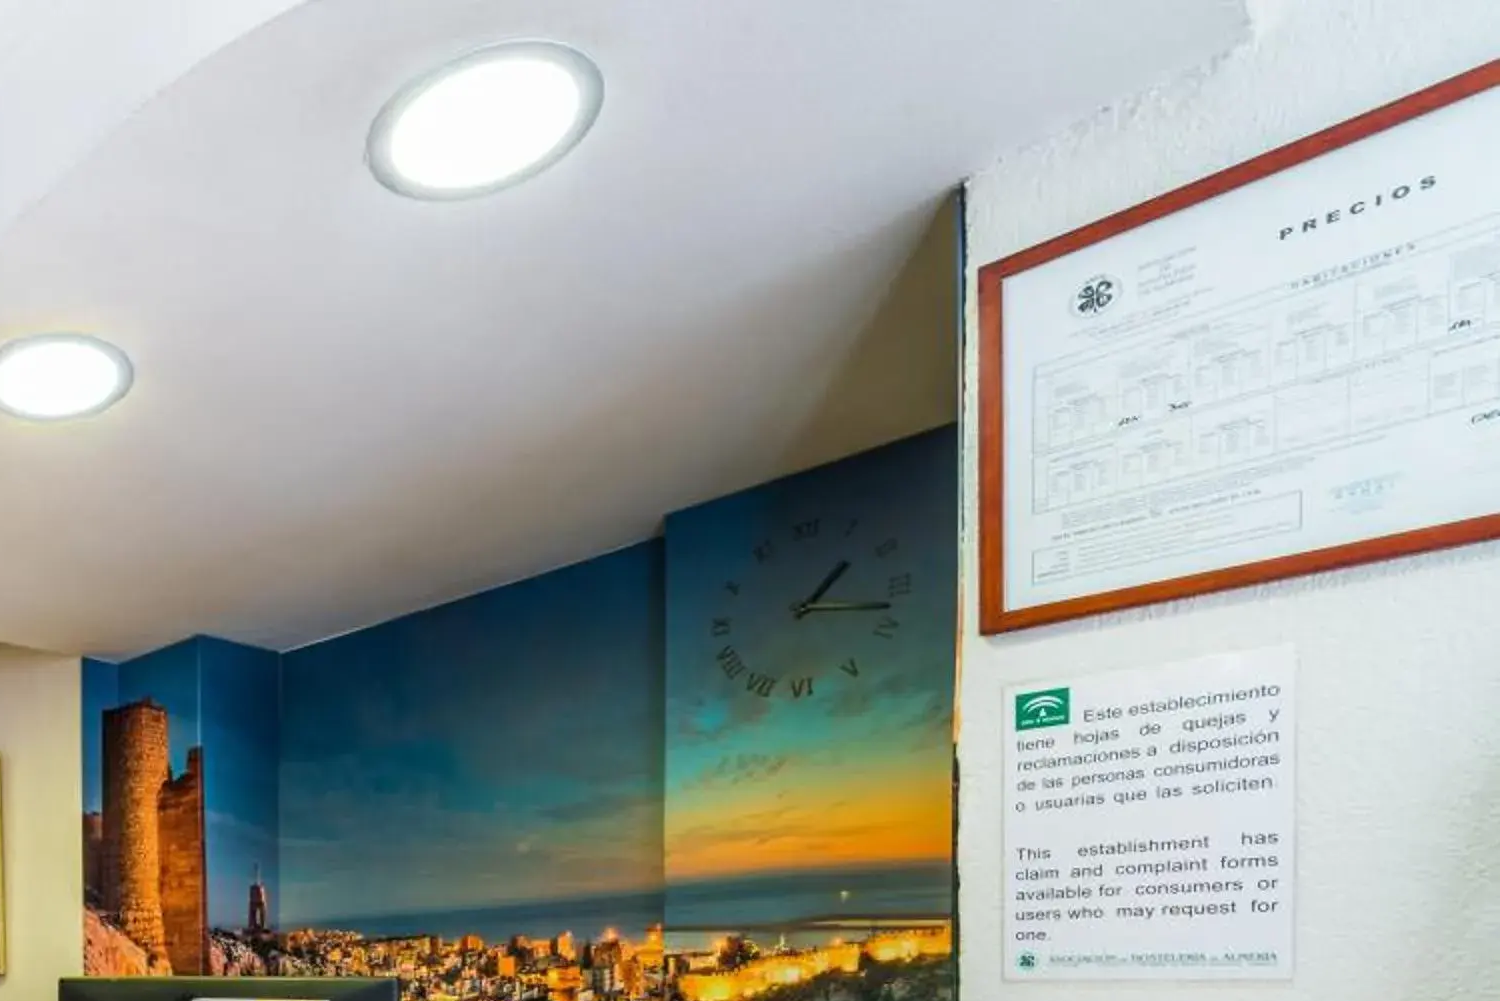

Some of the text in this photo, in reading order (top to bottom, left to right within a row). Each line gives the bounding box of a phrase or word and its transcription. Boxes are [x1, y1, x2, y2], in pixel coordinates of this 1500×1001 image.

[1277, 174, 1438, 241] PRECIOS
[789, 677, 814, 699] VI
[1083, 706, 1122, 723] Este
[1128, 684, 1281, 714] establecimiento
[1016, 708, 1280, 753] tiene hojas de quejas y
[1016, 729, 1280, 772] reclamaciones a disposición
[1016, 752, 1281, 792] de las personas consumidoras
[1015, 801, 1026, 813] o
[1035, 793, 1105, 811] usuarias
[1113, 789, 1147, 805] que
[1156, 785, 1183, 799] las
[1016, 832, 1279, 861] This establishment has
[1015, 855, 1279, 881] claim and complaint forms
[1015, 878, 1279, 901] available for consumers or
[1015, 899, 1279, 921] users who may request for
